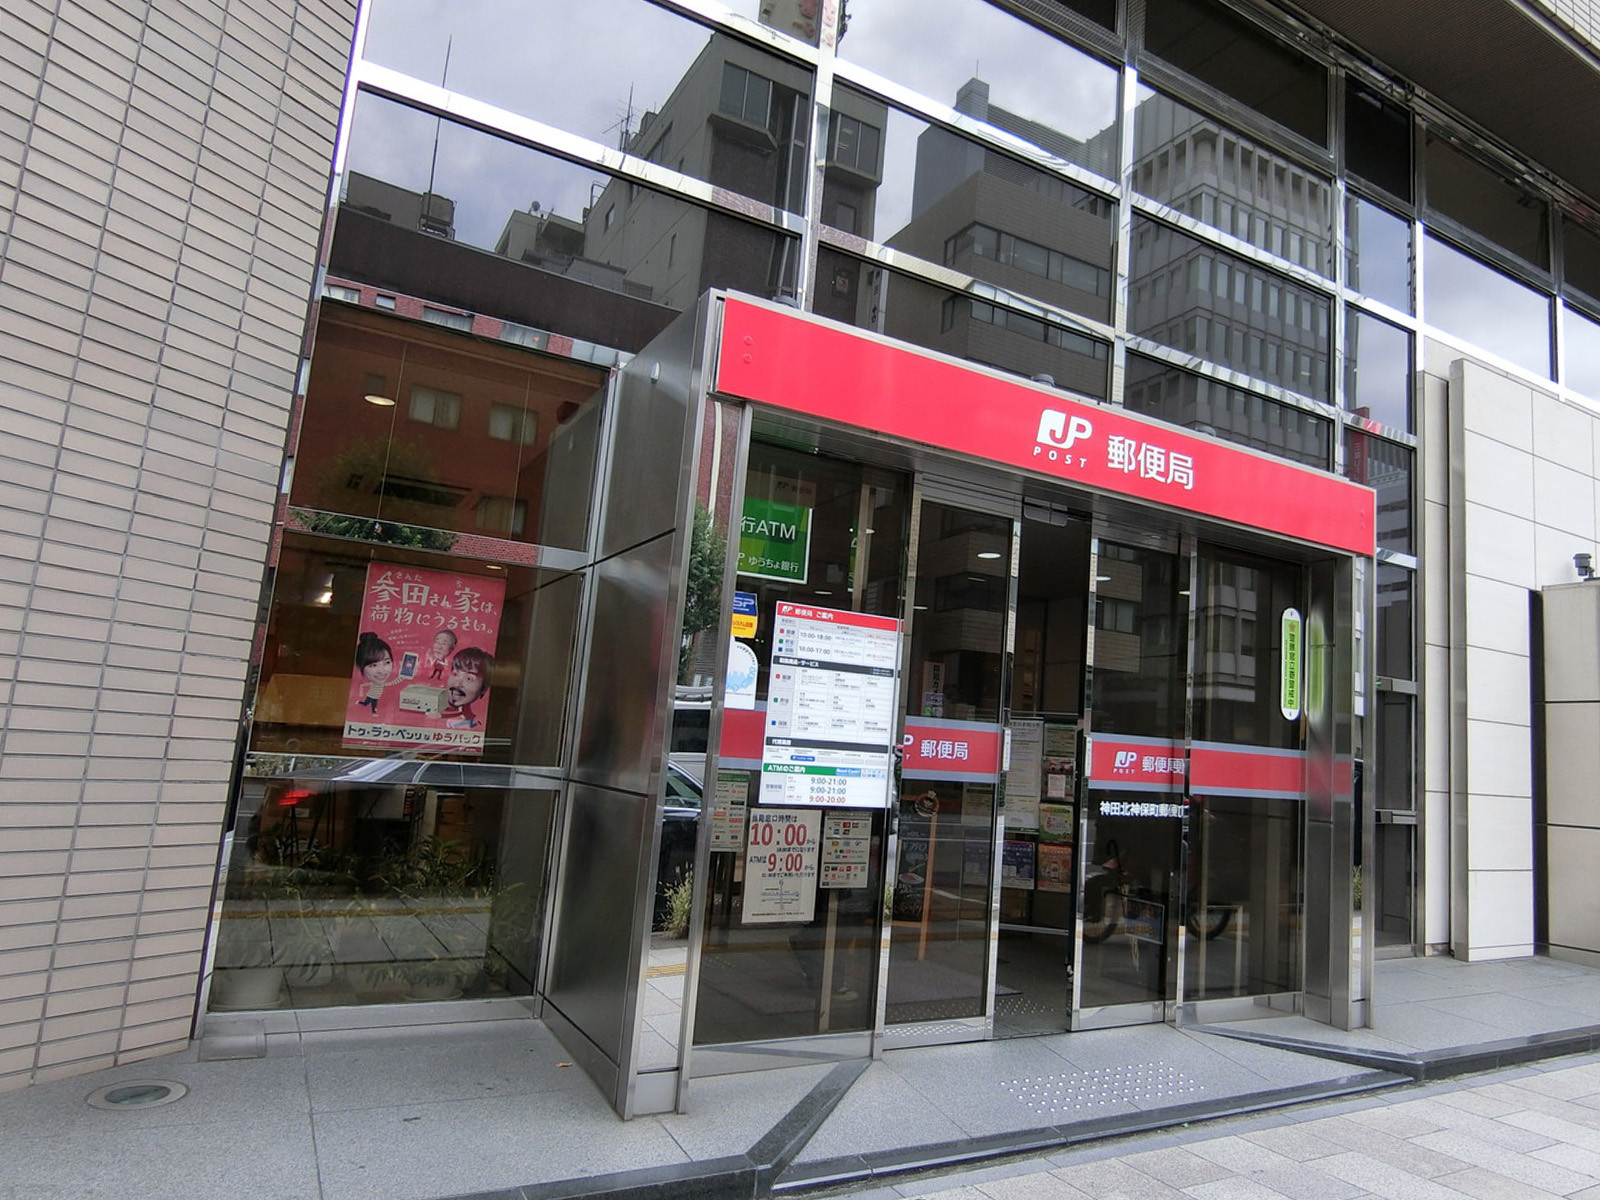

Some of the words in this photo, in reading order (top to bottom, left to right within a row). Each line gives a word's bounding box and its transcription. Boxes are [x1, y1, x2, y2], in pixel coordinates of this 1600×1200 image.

[1036, 409, 1093, 449] JP
[1033, 445, 1088, 468] POST
[1107, 435, 1194, 490] 郵便局
[748, 556, 799, 573] ゆうちょ銀行
[371, 604, 493, 635] 荷物にうるさい。
[921, 739, 969, 760] 郵便局
[810, 777, 847, 785] 9:00-21:00
[810, 787, 846, 795] 9:00-21:00
[809, 796, 846, 804] 9:00-20:00
[750, 823, 808, 846] 10:00
[768, 853, 803, 872] 9:00
